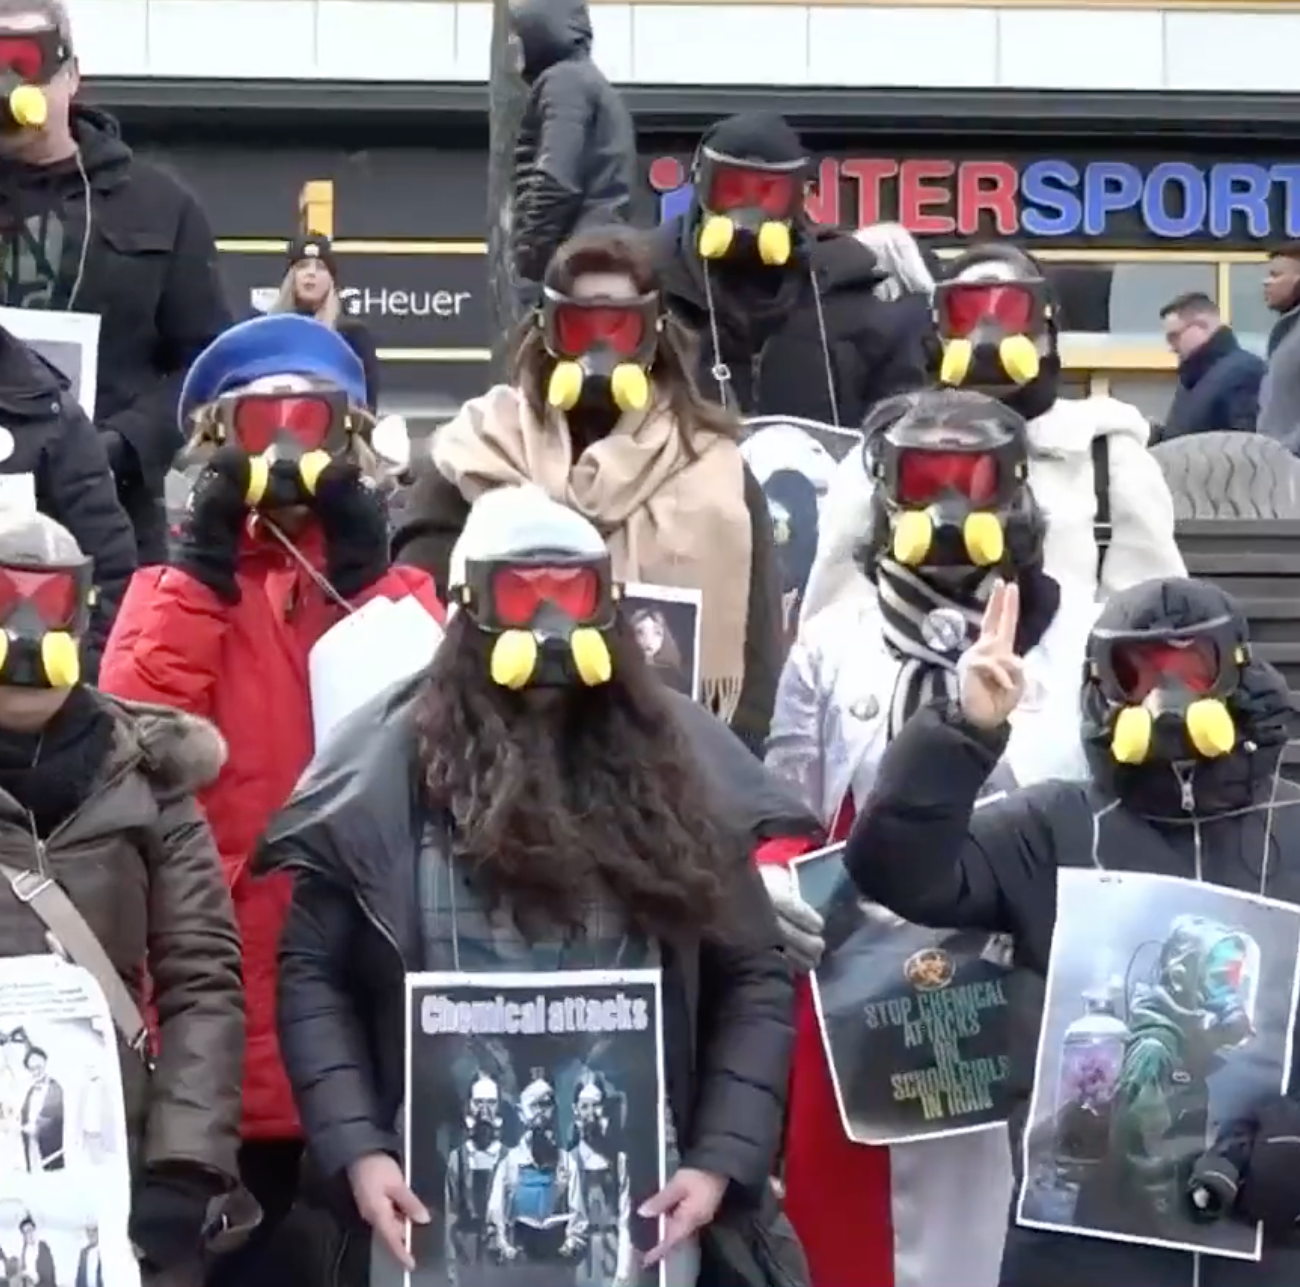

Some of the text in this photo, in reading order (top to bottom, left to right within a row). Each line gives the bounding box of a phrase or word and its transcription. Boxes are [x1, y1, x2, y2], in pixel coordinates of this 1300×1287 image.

[803, 156, 1300, 238] NTERSPORT
[339, 288, 472, 316] GHeuer
[420, 991, 649, 1035] Chemical attacks
[863, 979, 1009, 1030] STOP CHEMICAL
[902, 1009, 982, 1049] ATTACKS
[890, 1054, 1011, 1101] SCHOOLGIRLS
[920, 1080, 995, 1121] IN IRAN
